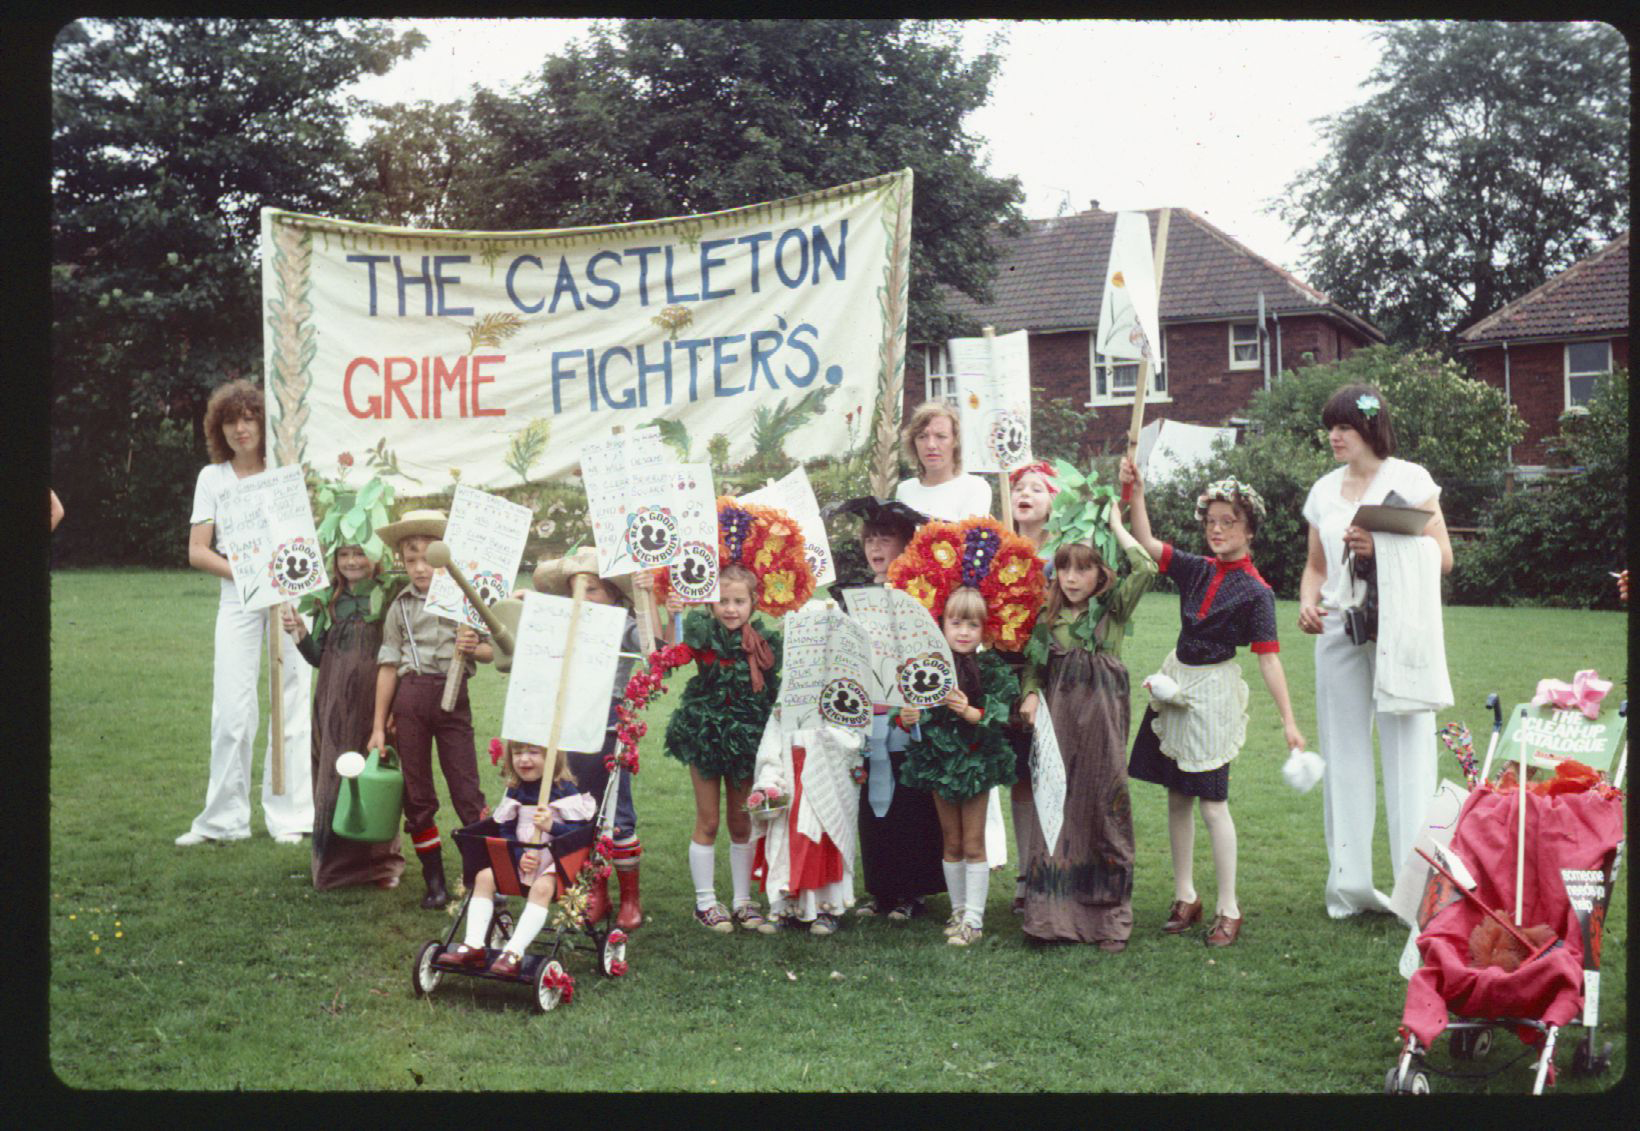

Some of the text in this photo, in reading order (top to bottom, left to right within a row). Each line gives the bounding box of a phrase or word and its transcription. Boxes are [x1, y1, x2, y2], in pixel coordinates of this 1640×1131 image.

[347, 219, 849, 317] THE CASTLETON
[342, 354, 507, 420] GRIME
[648, 512, 676, 532] GOOD
[291, 543, 316, 559] GOOD
[632, 533, 679, 563] NEIGHBOUR
[692, 546, 716, 570] GOOD
[276, 558, 319, 591] NEIGHBOUR
[671, 570, 717, 597] NEIGHBOUR
[874, 639, 923, 654] EYWOOD
[901, 659, 951, 684] BE A GOOD
[846, 681, 870, 708] GOOD
[901, 677, 954, 703] NEIGHBOUR
[822, 700, 870, 726] NEIGHBOUR
[1552, 710, 1583, 724] THE
